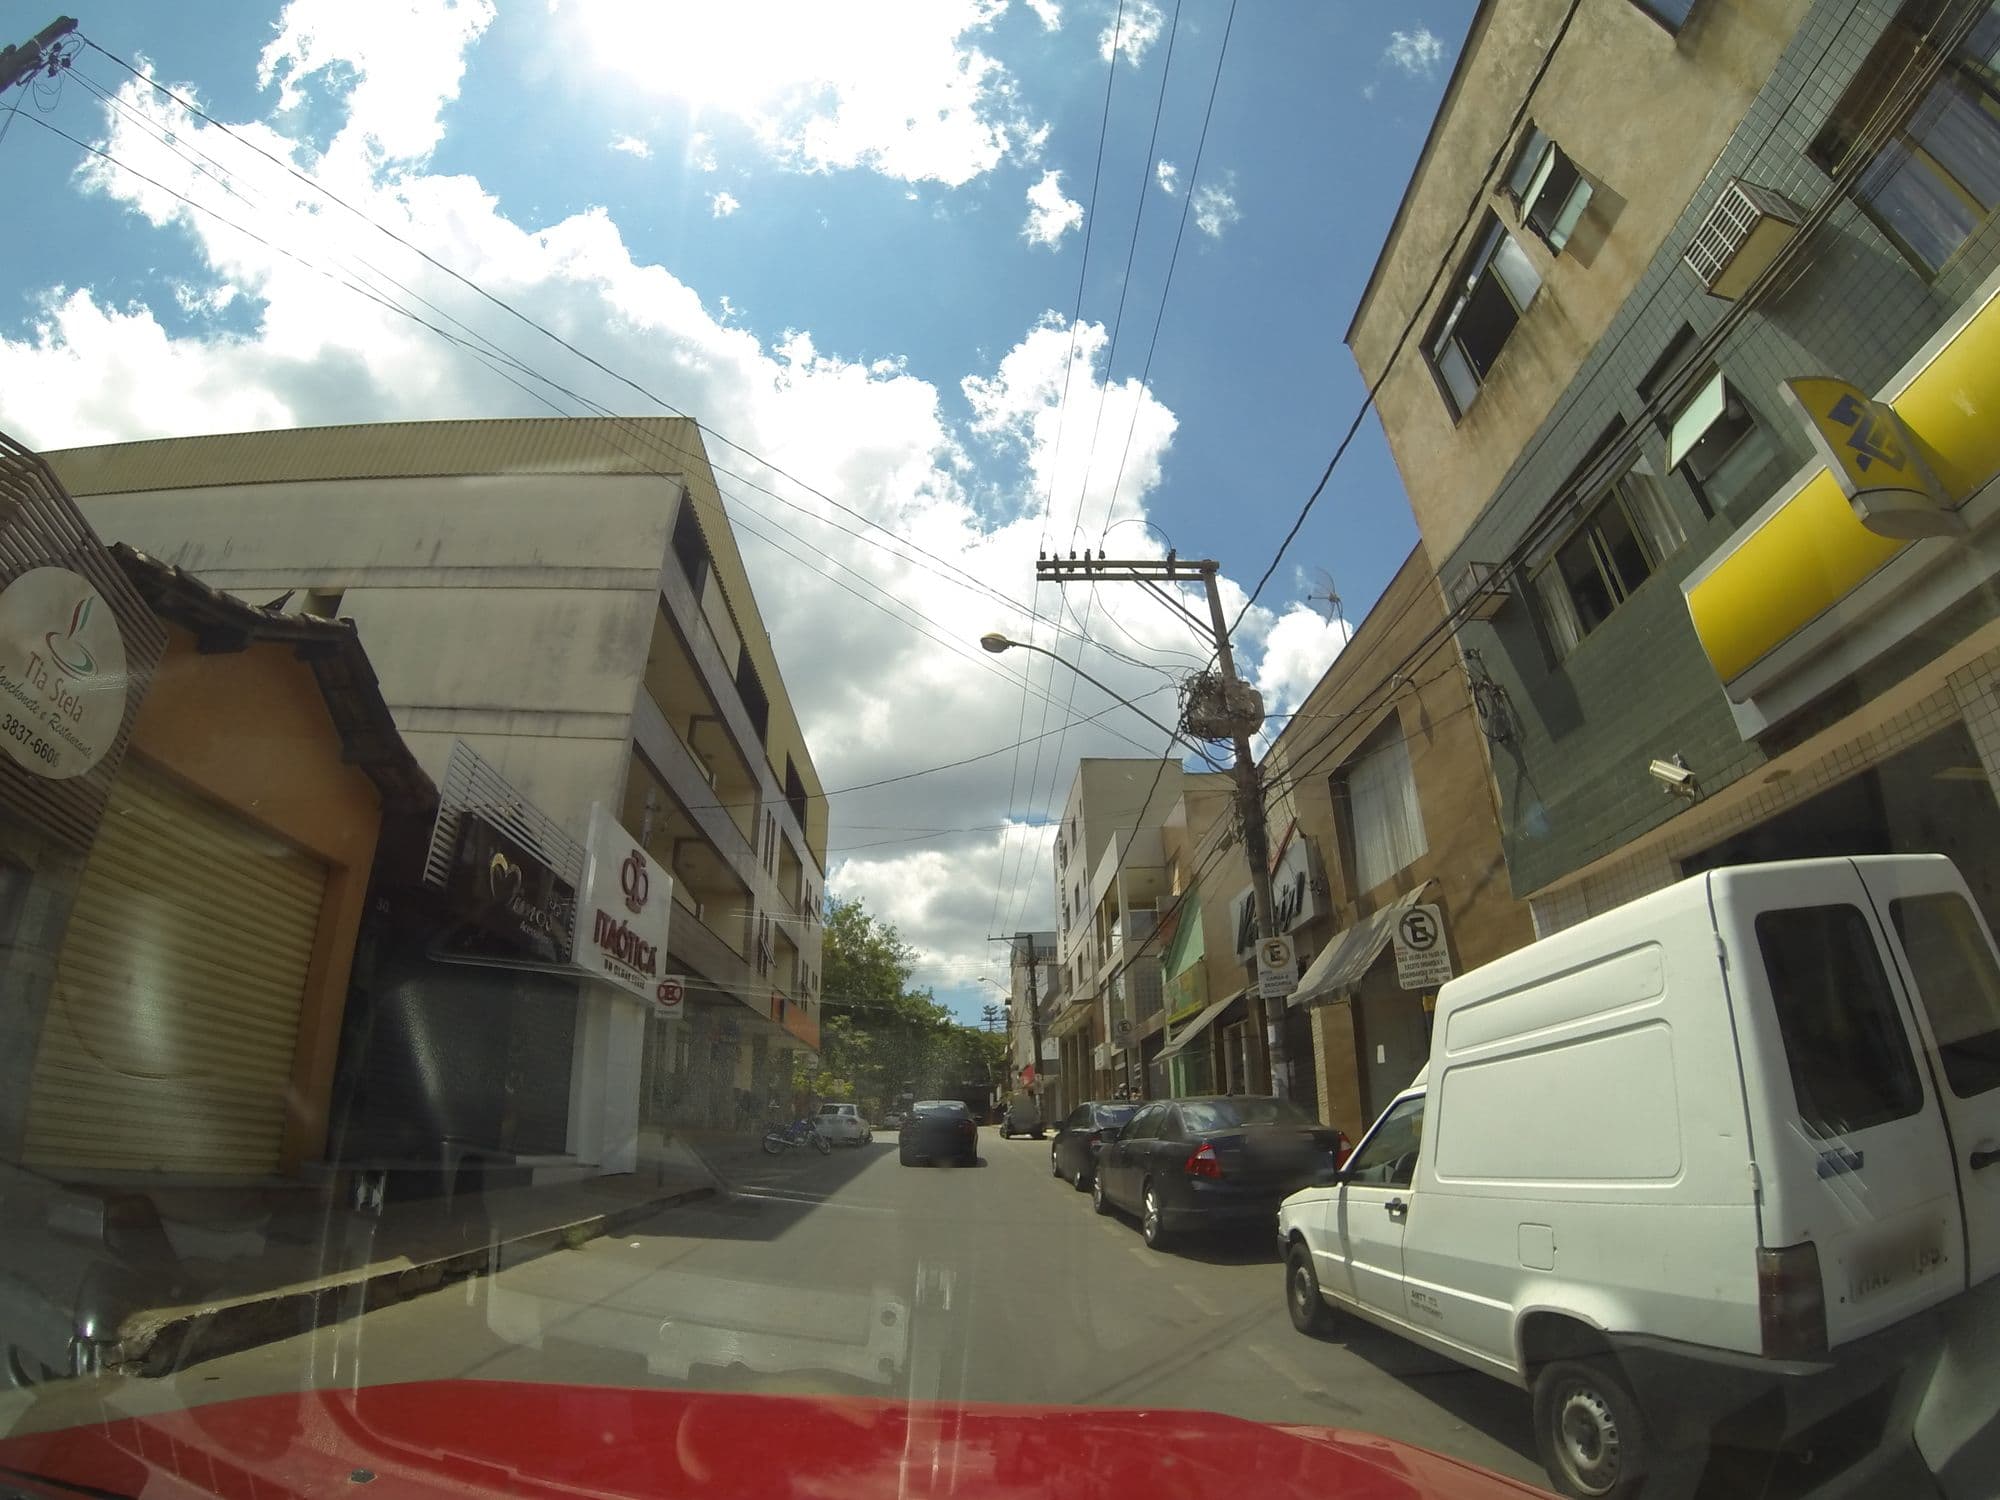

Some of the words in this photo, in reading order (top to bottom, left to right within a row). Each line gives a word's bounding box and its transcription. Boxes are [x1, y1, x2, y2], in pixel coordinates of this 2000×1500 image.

[25, 651, 48, 691] Tia
[49, 678, 83, 722] Stela
[594, 908, 658, 977] ITAÓTICA
